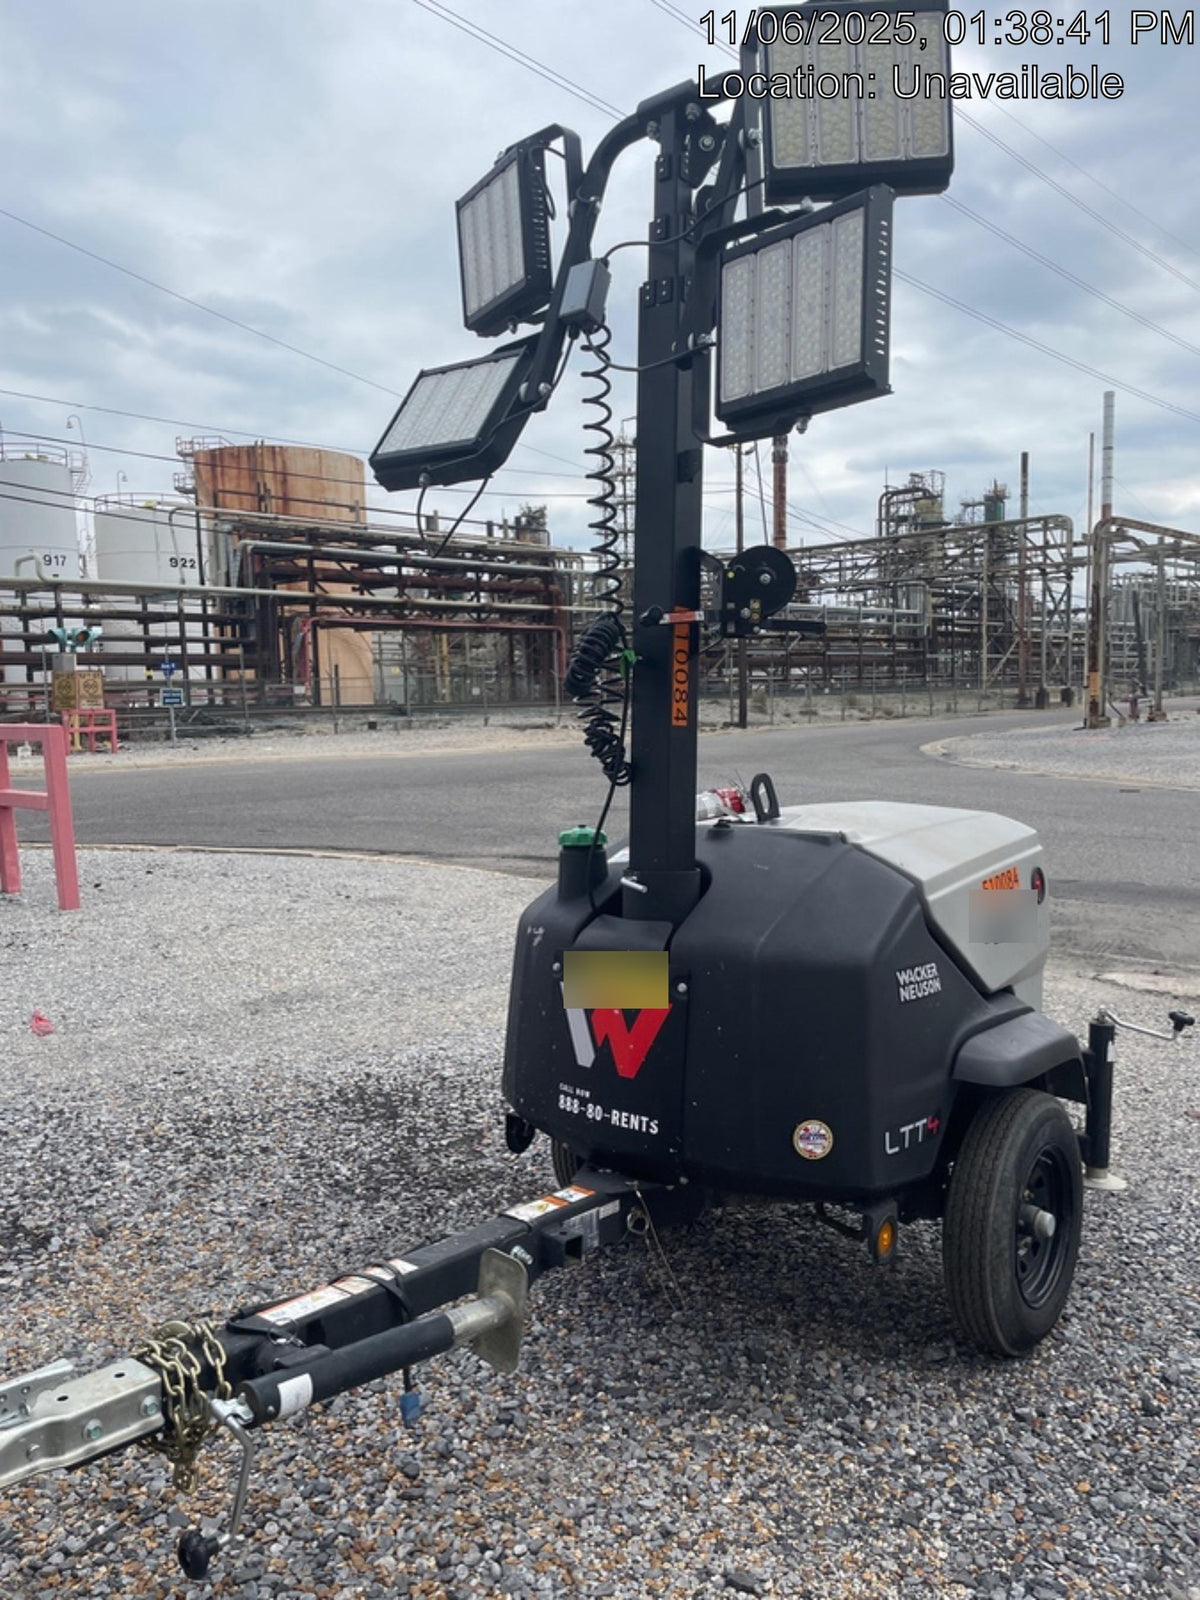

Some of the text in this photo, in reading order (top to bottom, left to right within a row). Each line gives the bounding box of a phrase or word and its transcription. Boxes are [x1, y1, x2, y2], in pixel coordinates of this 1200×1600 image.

[43, 554, 67, 567] 917
[169, 557, 196, 569] 922
[895, 962, 939, 986] WACKER
[899, 977, 942, 1002] NEUSON
[558, 1094, 659, 1135] 888-80-RENTS
[884, 1115, 939, 1154] LTT4
